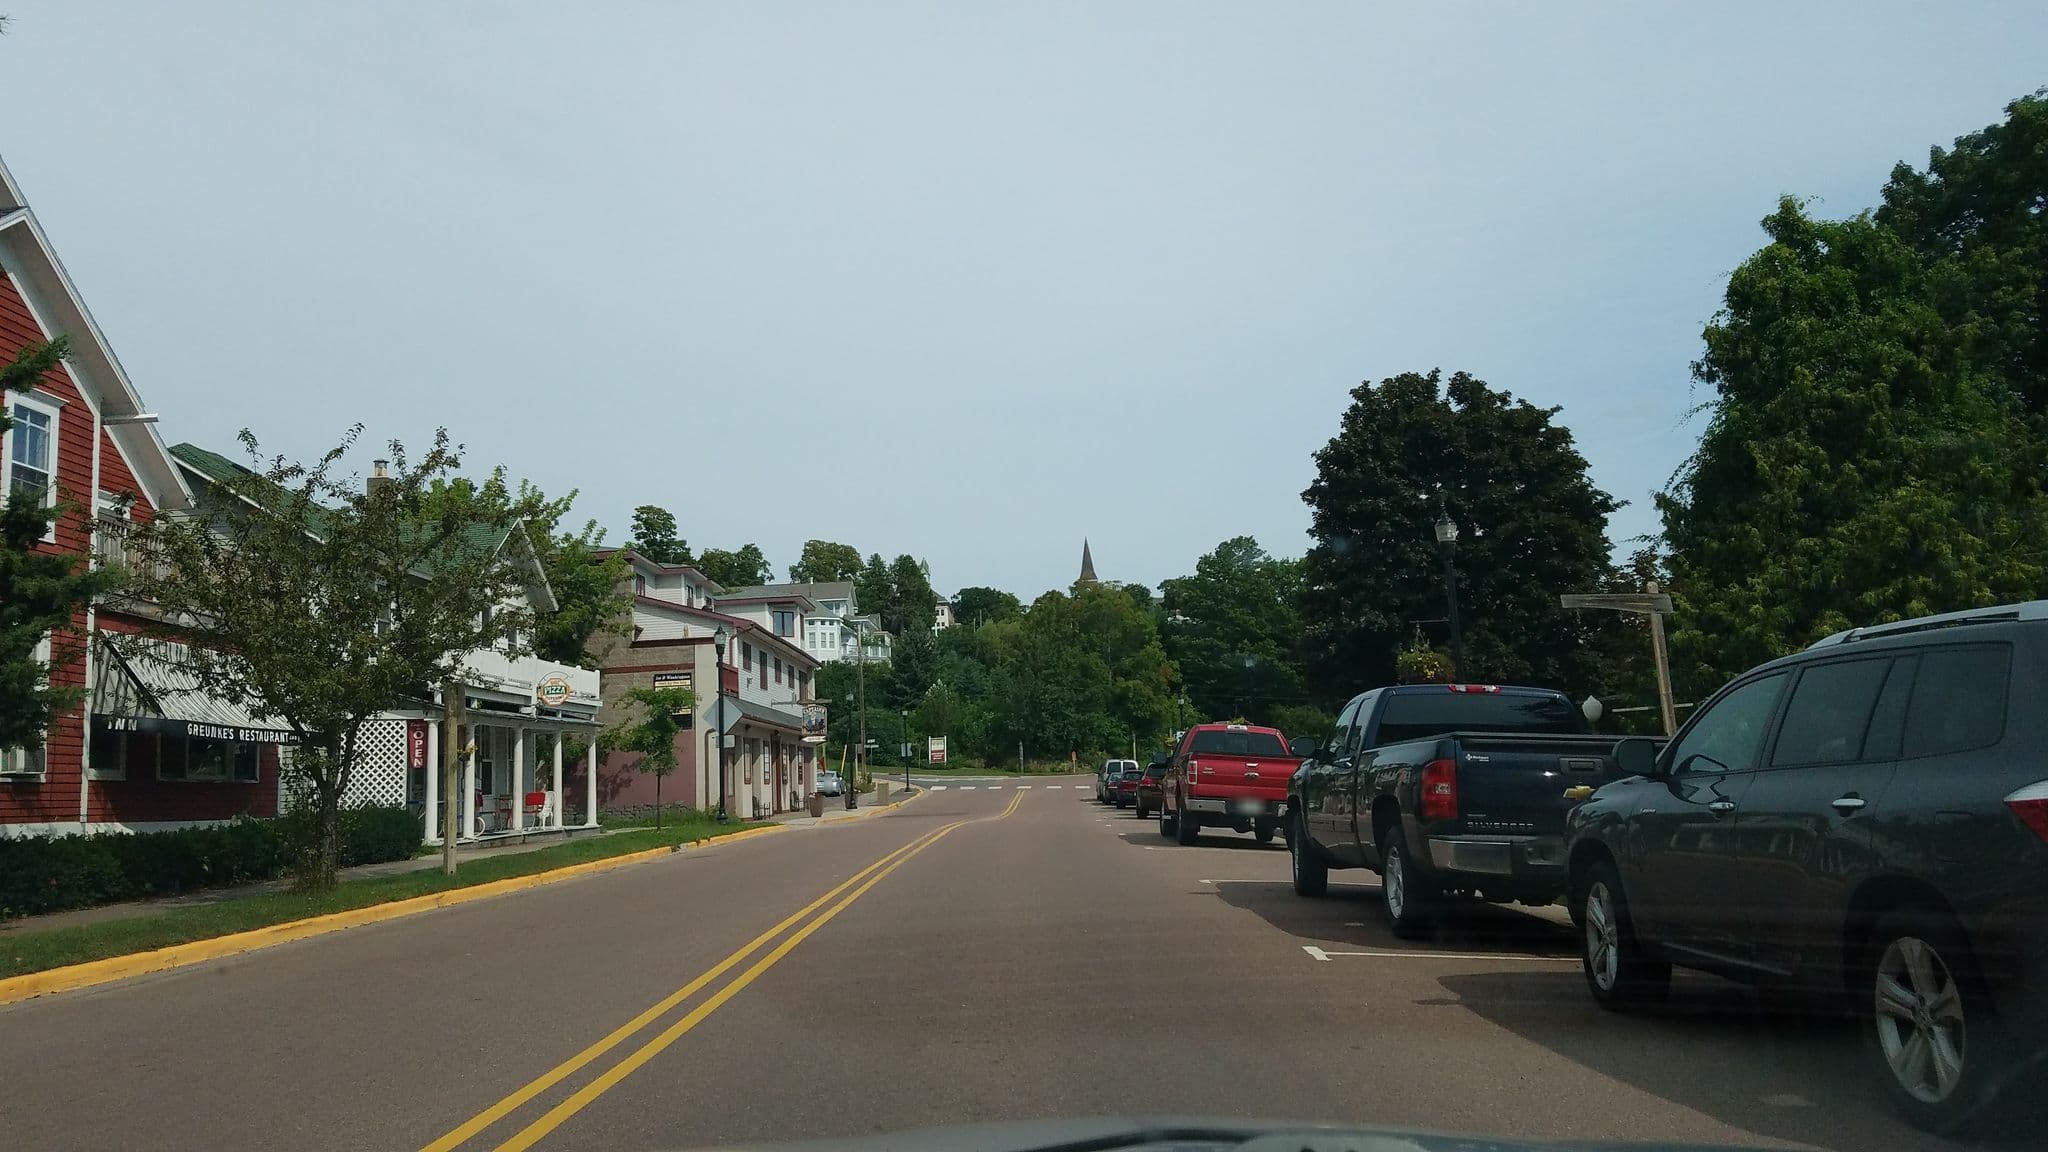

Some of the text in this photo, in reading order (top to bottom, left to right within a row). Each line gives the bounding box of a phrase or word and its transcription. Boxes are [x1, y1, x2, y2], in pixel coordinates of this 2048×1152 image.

[544, 686, 565, 695] PIZZA
[187, 722, 234, 740] GREUNKE'S
[239, 729, 289, 743] RESTAURANT
[413, 730, 424, 768] OPEN
